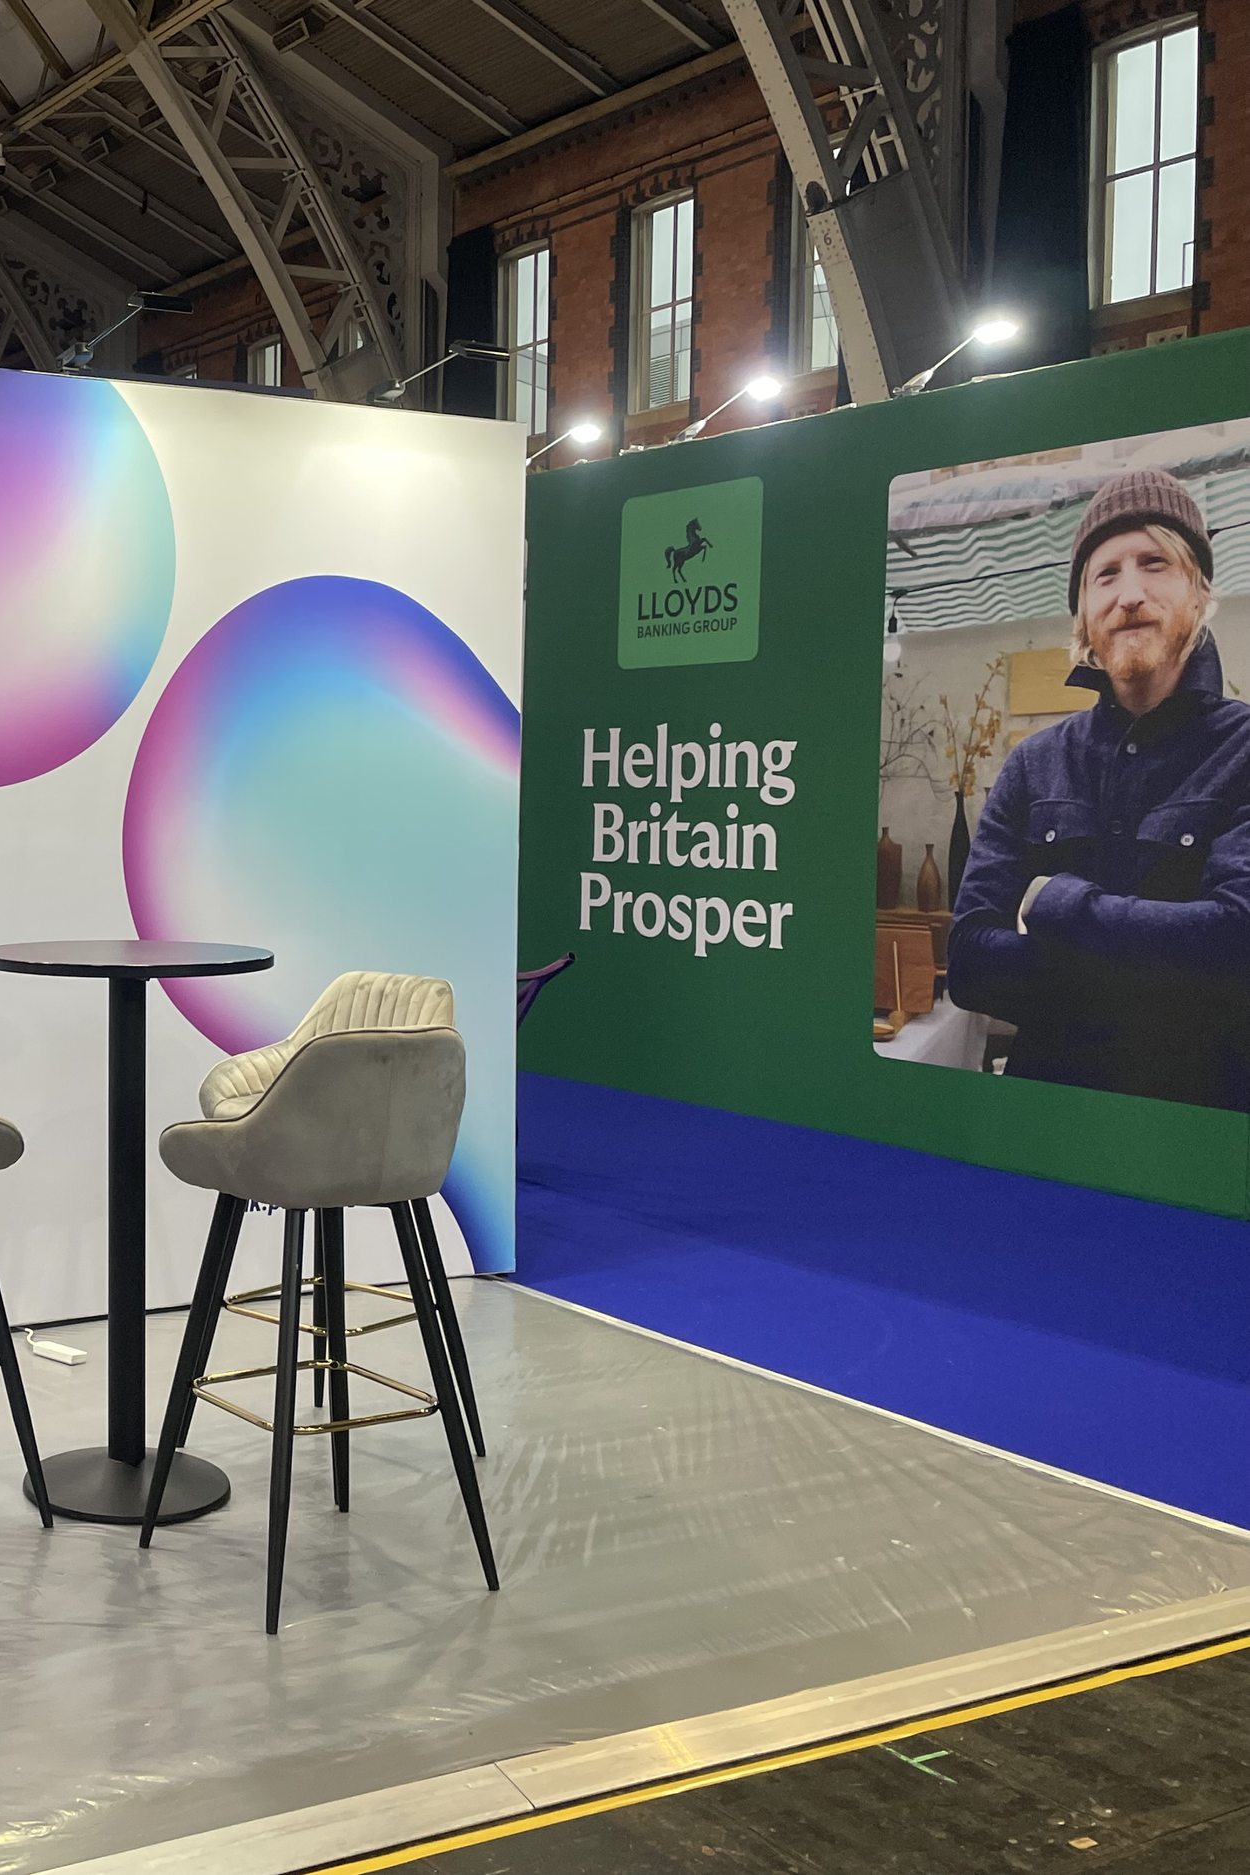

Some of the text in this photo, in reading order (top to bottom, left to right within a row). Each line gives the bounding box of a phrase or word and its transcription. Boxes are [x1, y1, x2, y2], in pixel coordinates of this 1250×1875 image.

[637, 583, 738, 621] LLOYDS
[637, 617, 738, 639] BANKING GROUP
[581, 722, 798, 805] Helping
[592, 802, 778, 871] Britain
[579, 871, 794, 958] Prosper
